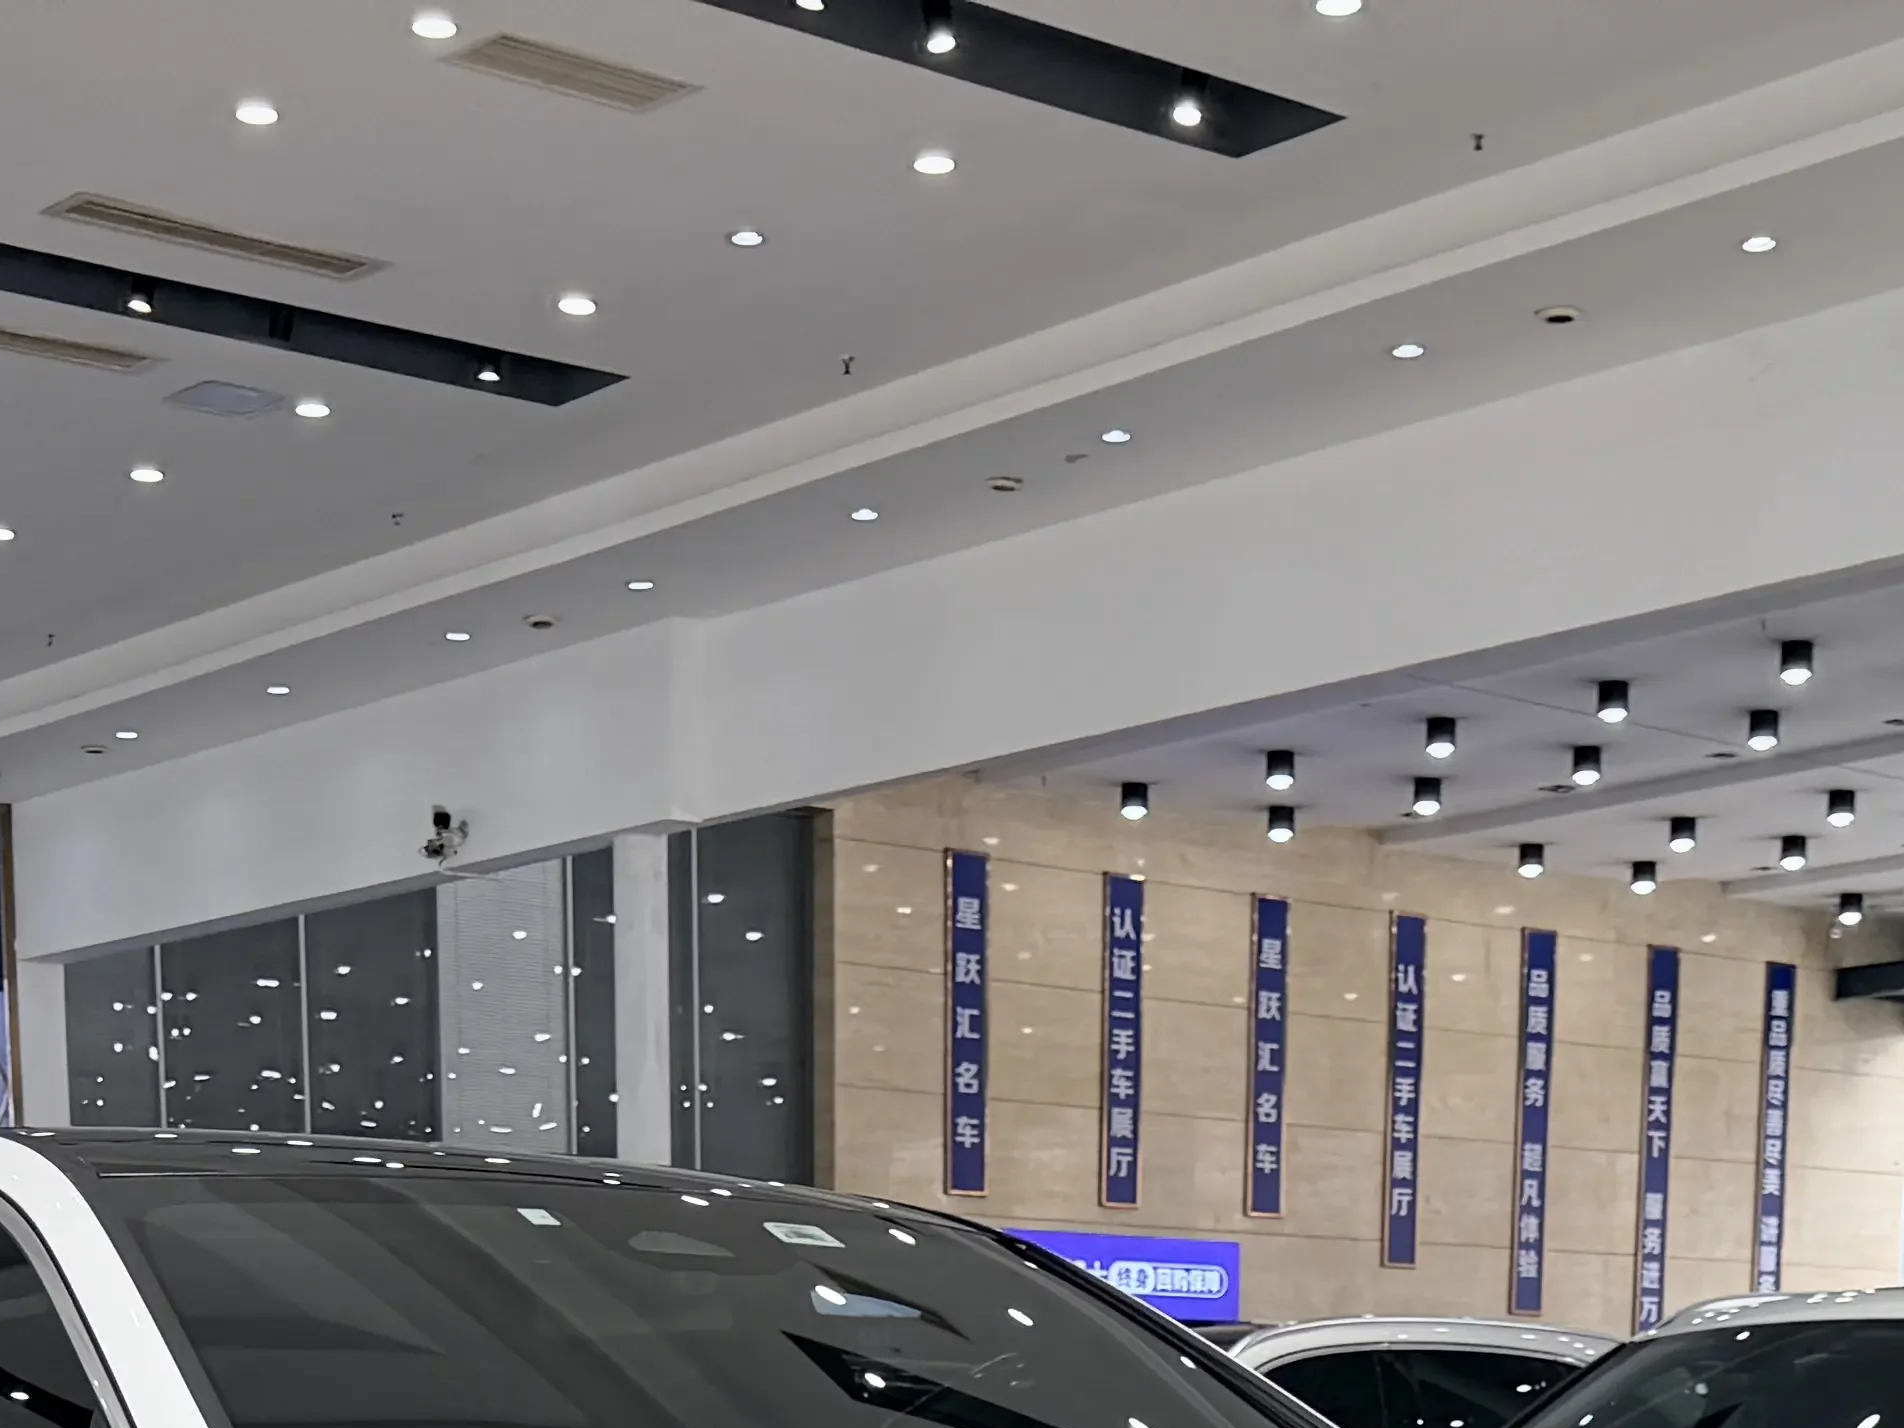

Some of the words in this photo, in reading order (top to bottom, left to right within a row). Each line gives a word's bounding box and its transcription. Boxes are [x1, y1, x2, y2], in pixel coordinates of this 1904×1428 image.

[1108, 907, 1137, 1179] 认证二手车展厅
